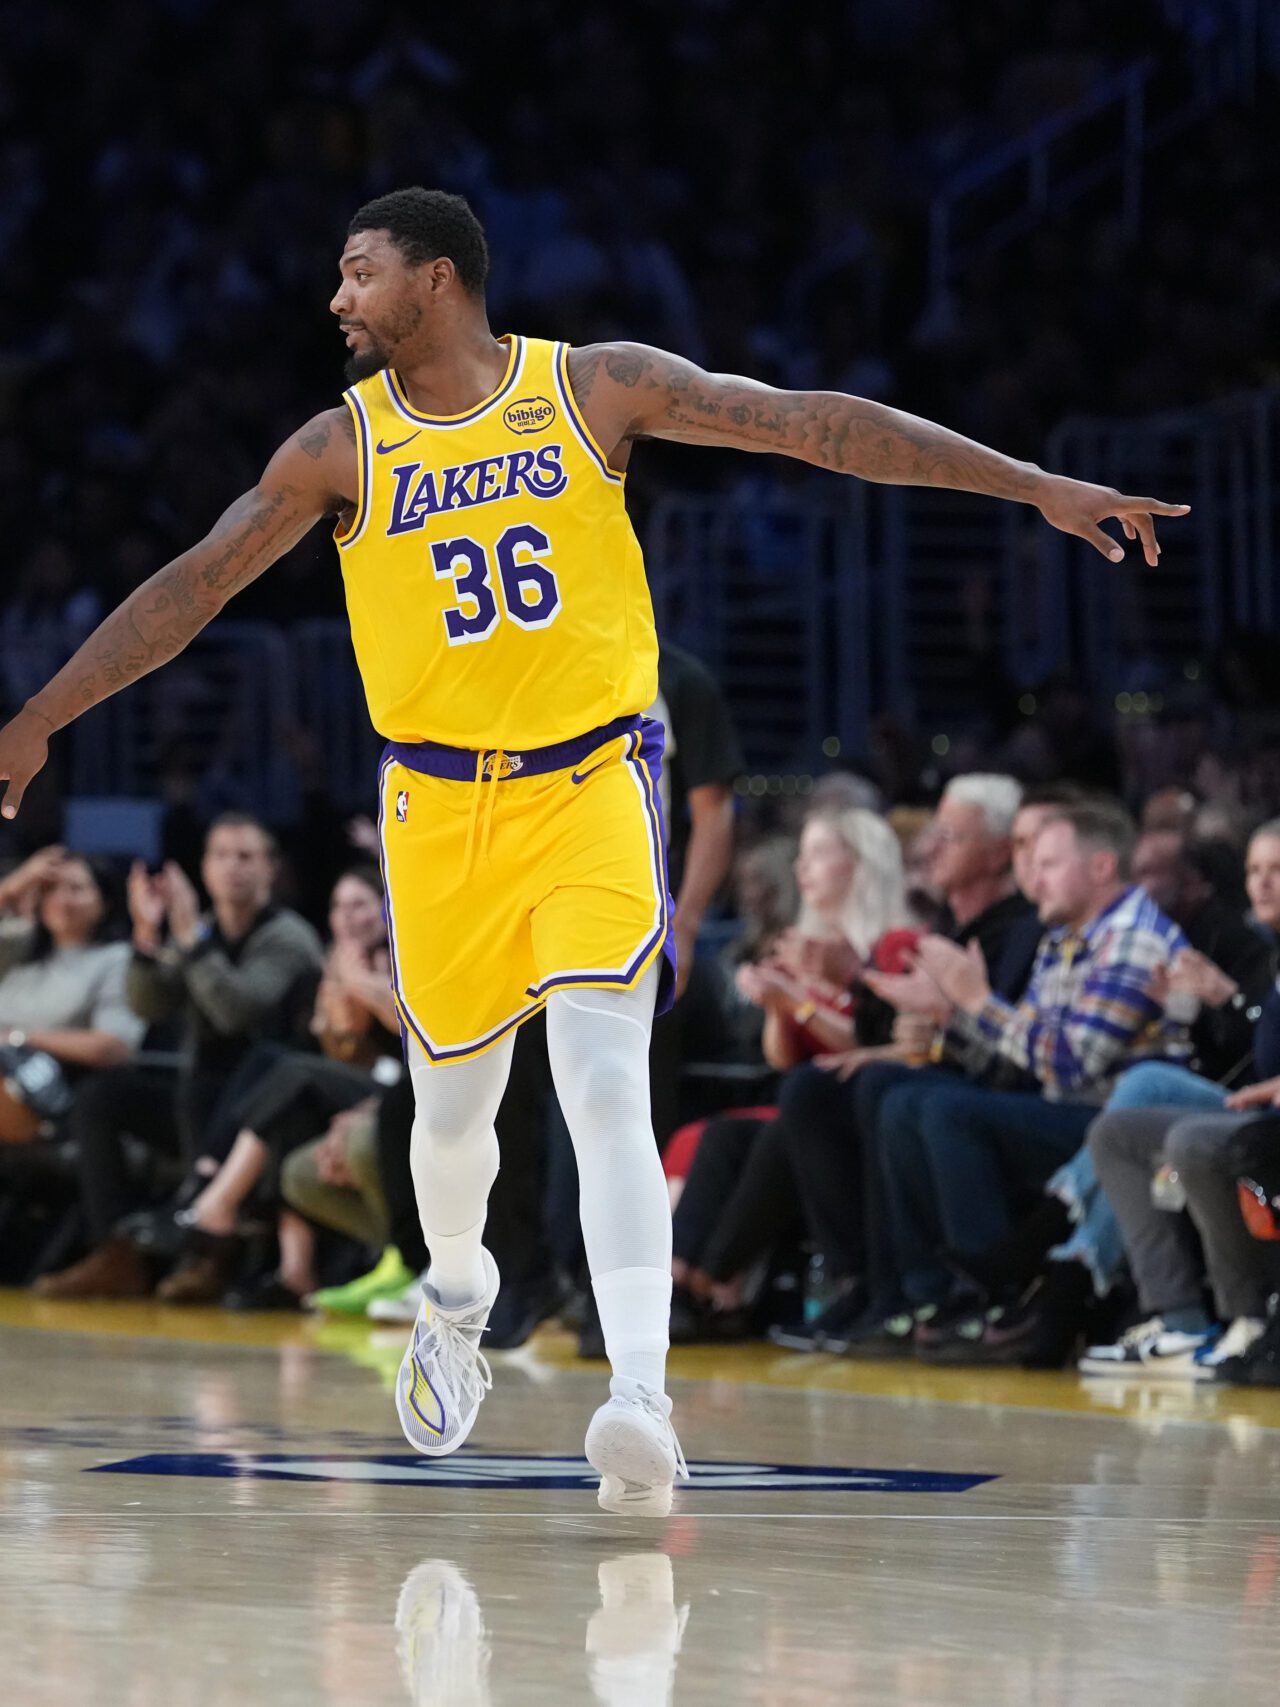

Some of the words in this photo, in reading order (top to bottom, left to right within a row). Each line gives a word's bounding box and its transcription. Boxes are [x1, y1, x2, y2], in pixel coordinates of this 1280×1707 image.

[507, 407, 552, 422] bibigo
[386, 444, 569, 537] LAKERS
[429, 523, 562, 647] 36
[483, 760, 520, 772] LAERS
